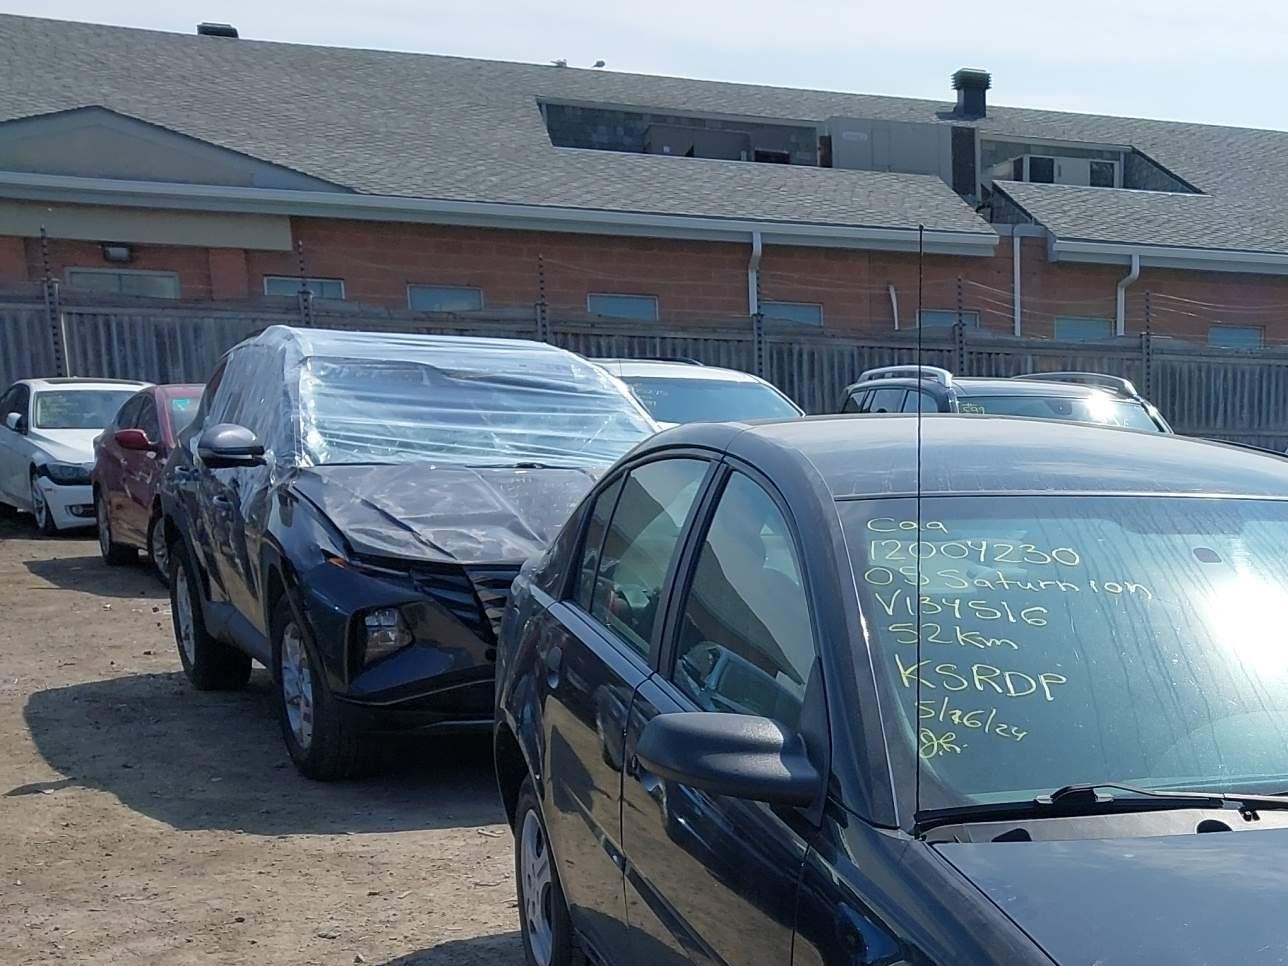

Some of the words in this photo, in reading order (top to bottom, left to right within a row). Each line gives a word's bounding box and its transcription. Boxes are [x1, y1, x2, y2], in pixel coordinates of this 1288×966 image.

[870, 539, 1080, 566] 12004230
[875, 589, 1048, 627] V134516
[895, 654, 1068, 701] KSRDP
